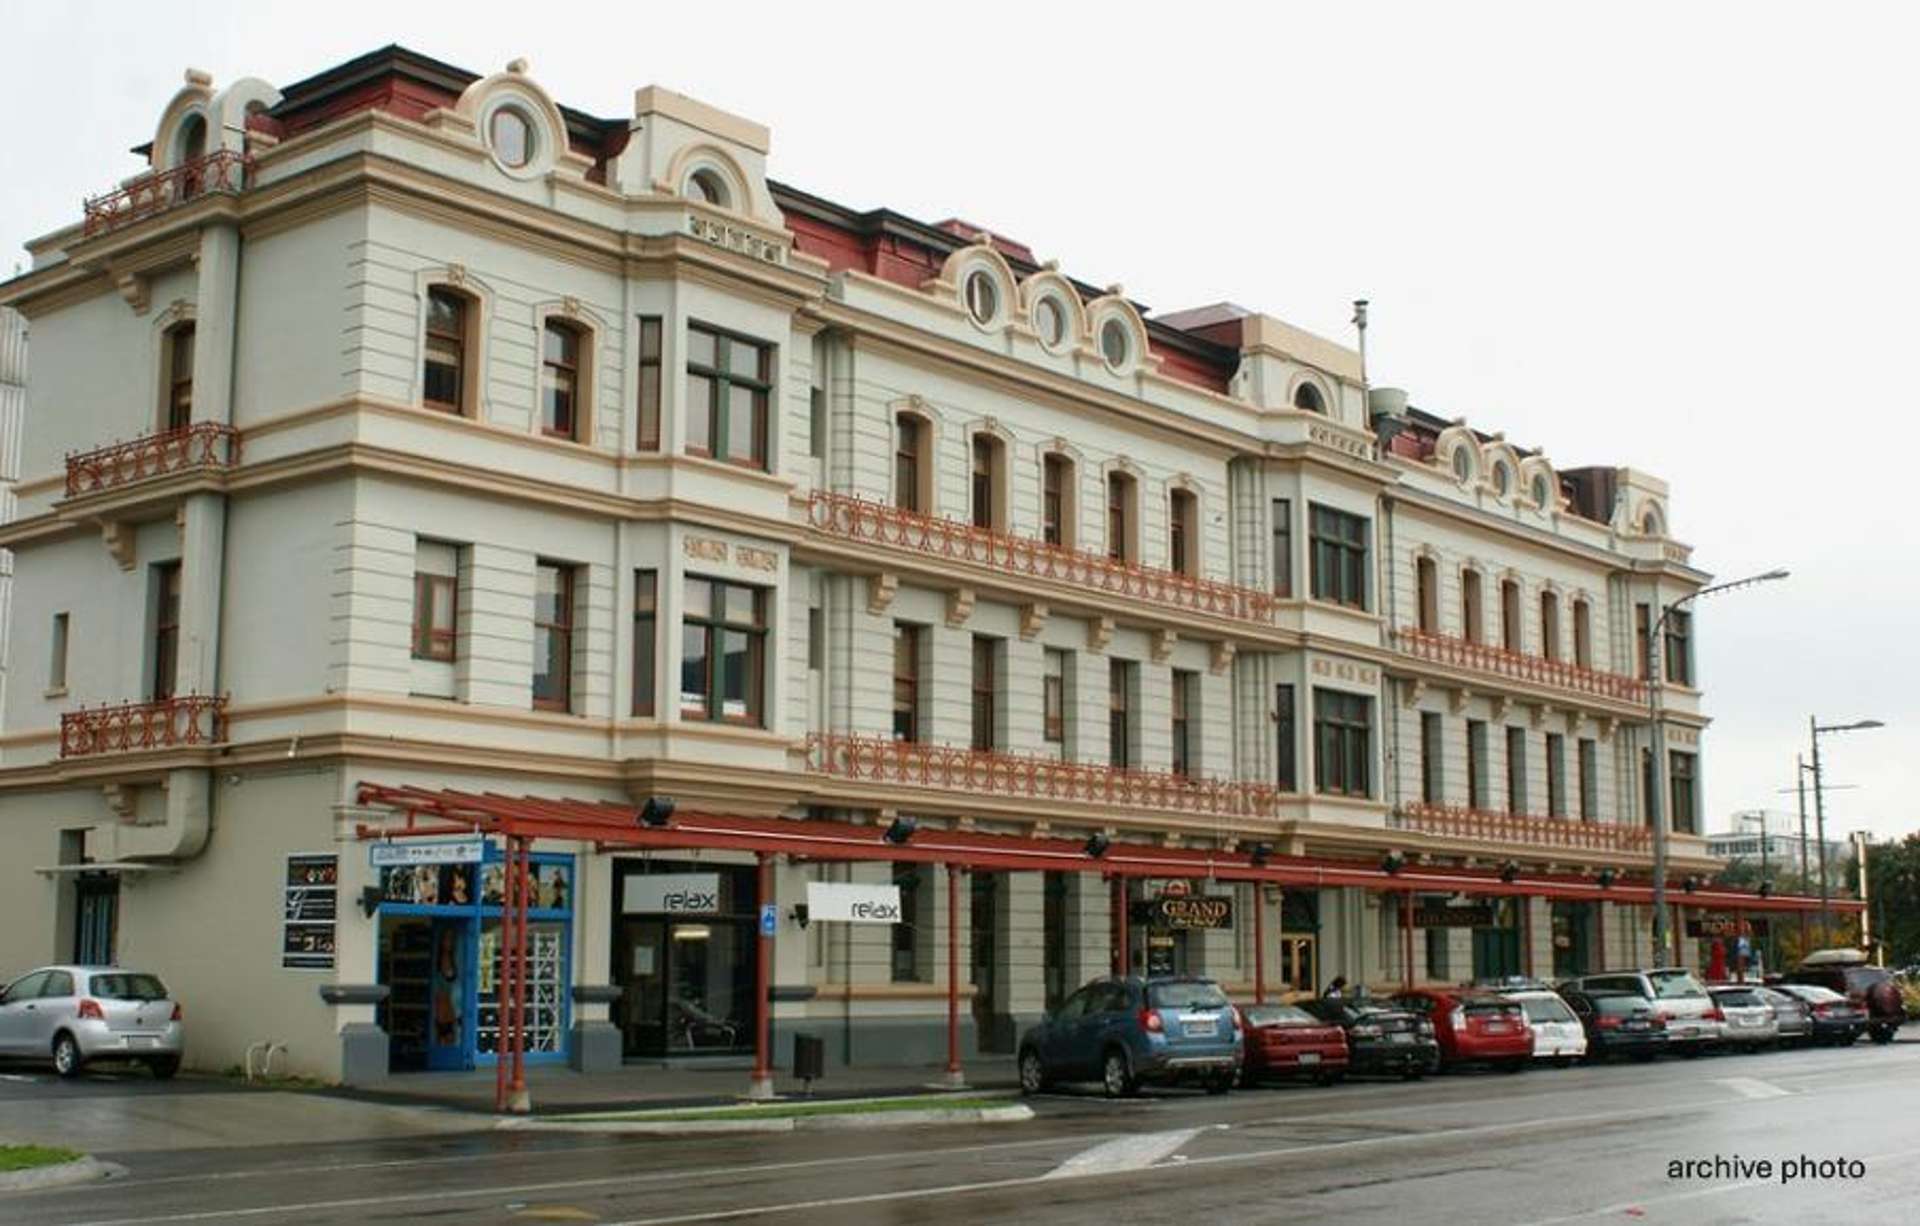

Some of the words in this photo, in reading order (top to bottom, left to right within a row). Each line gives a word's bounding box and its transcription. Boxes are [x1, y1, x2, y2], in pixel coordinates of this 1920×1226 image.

[663, 891, 715, 909] relax
[1162, 900, 1228, 917] GRAND
[851, 901, 899, 920] relax
